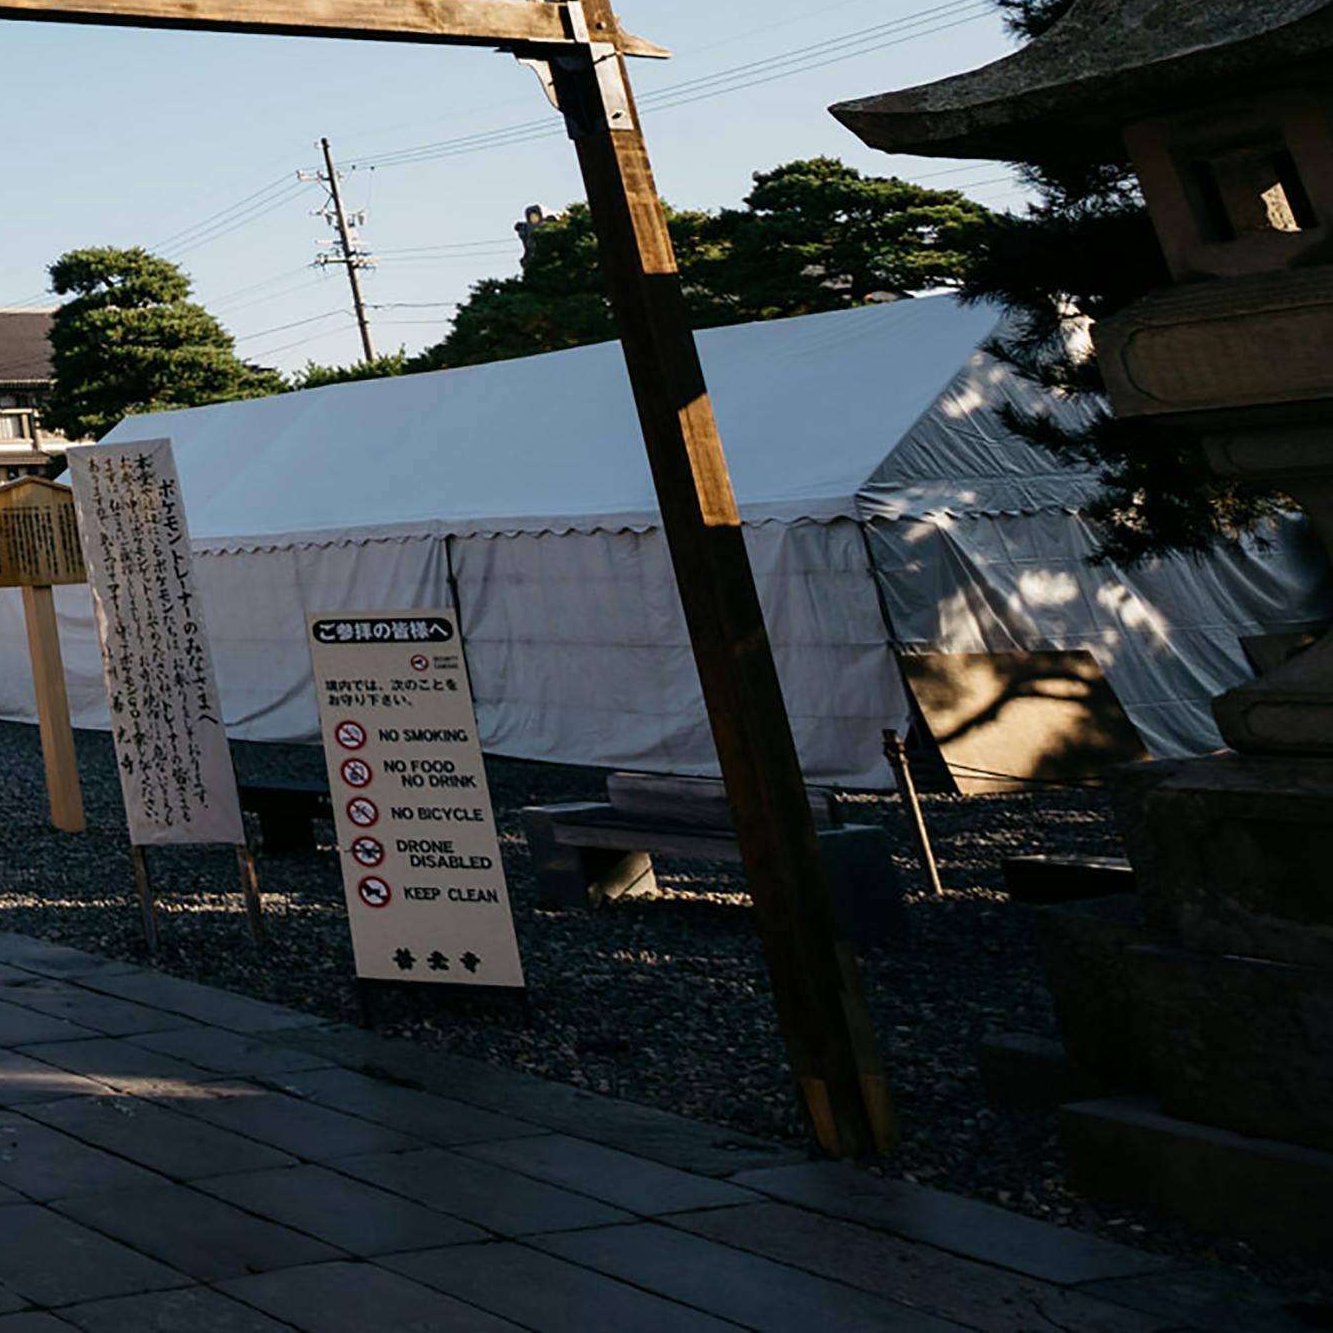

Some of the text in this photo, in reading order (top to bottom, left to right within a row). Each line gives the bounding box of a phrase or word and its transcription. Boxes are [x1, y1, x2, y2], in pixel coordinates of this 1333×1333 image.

[378, 729, 468, 743] NO SMOKING
[384, 760, 455, 773] NO FOOD
[401, 775, 476, 788] NO DRINK
[391, 807, 483, 822] NO BICYCLE
[396, 840, 492, 869] DRONE DISABLED
[404, 887, 498, 903] KEEP CLEAN
